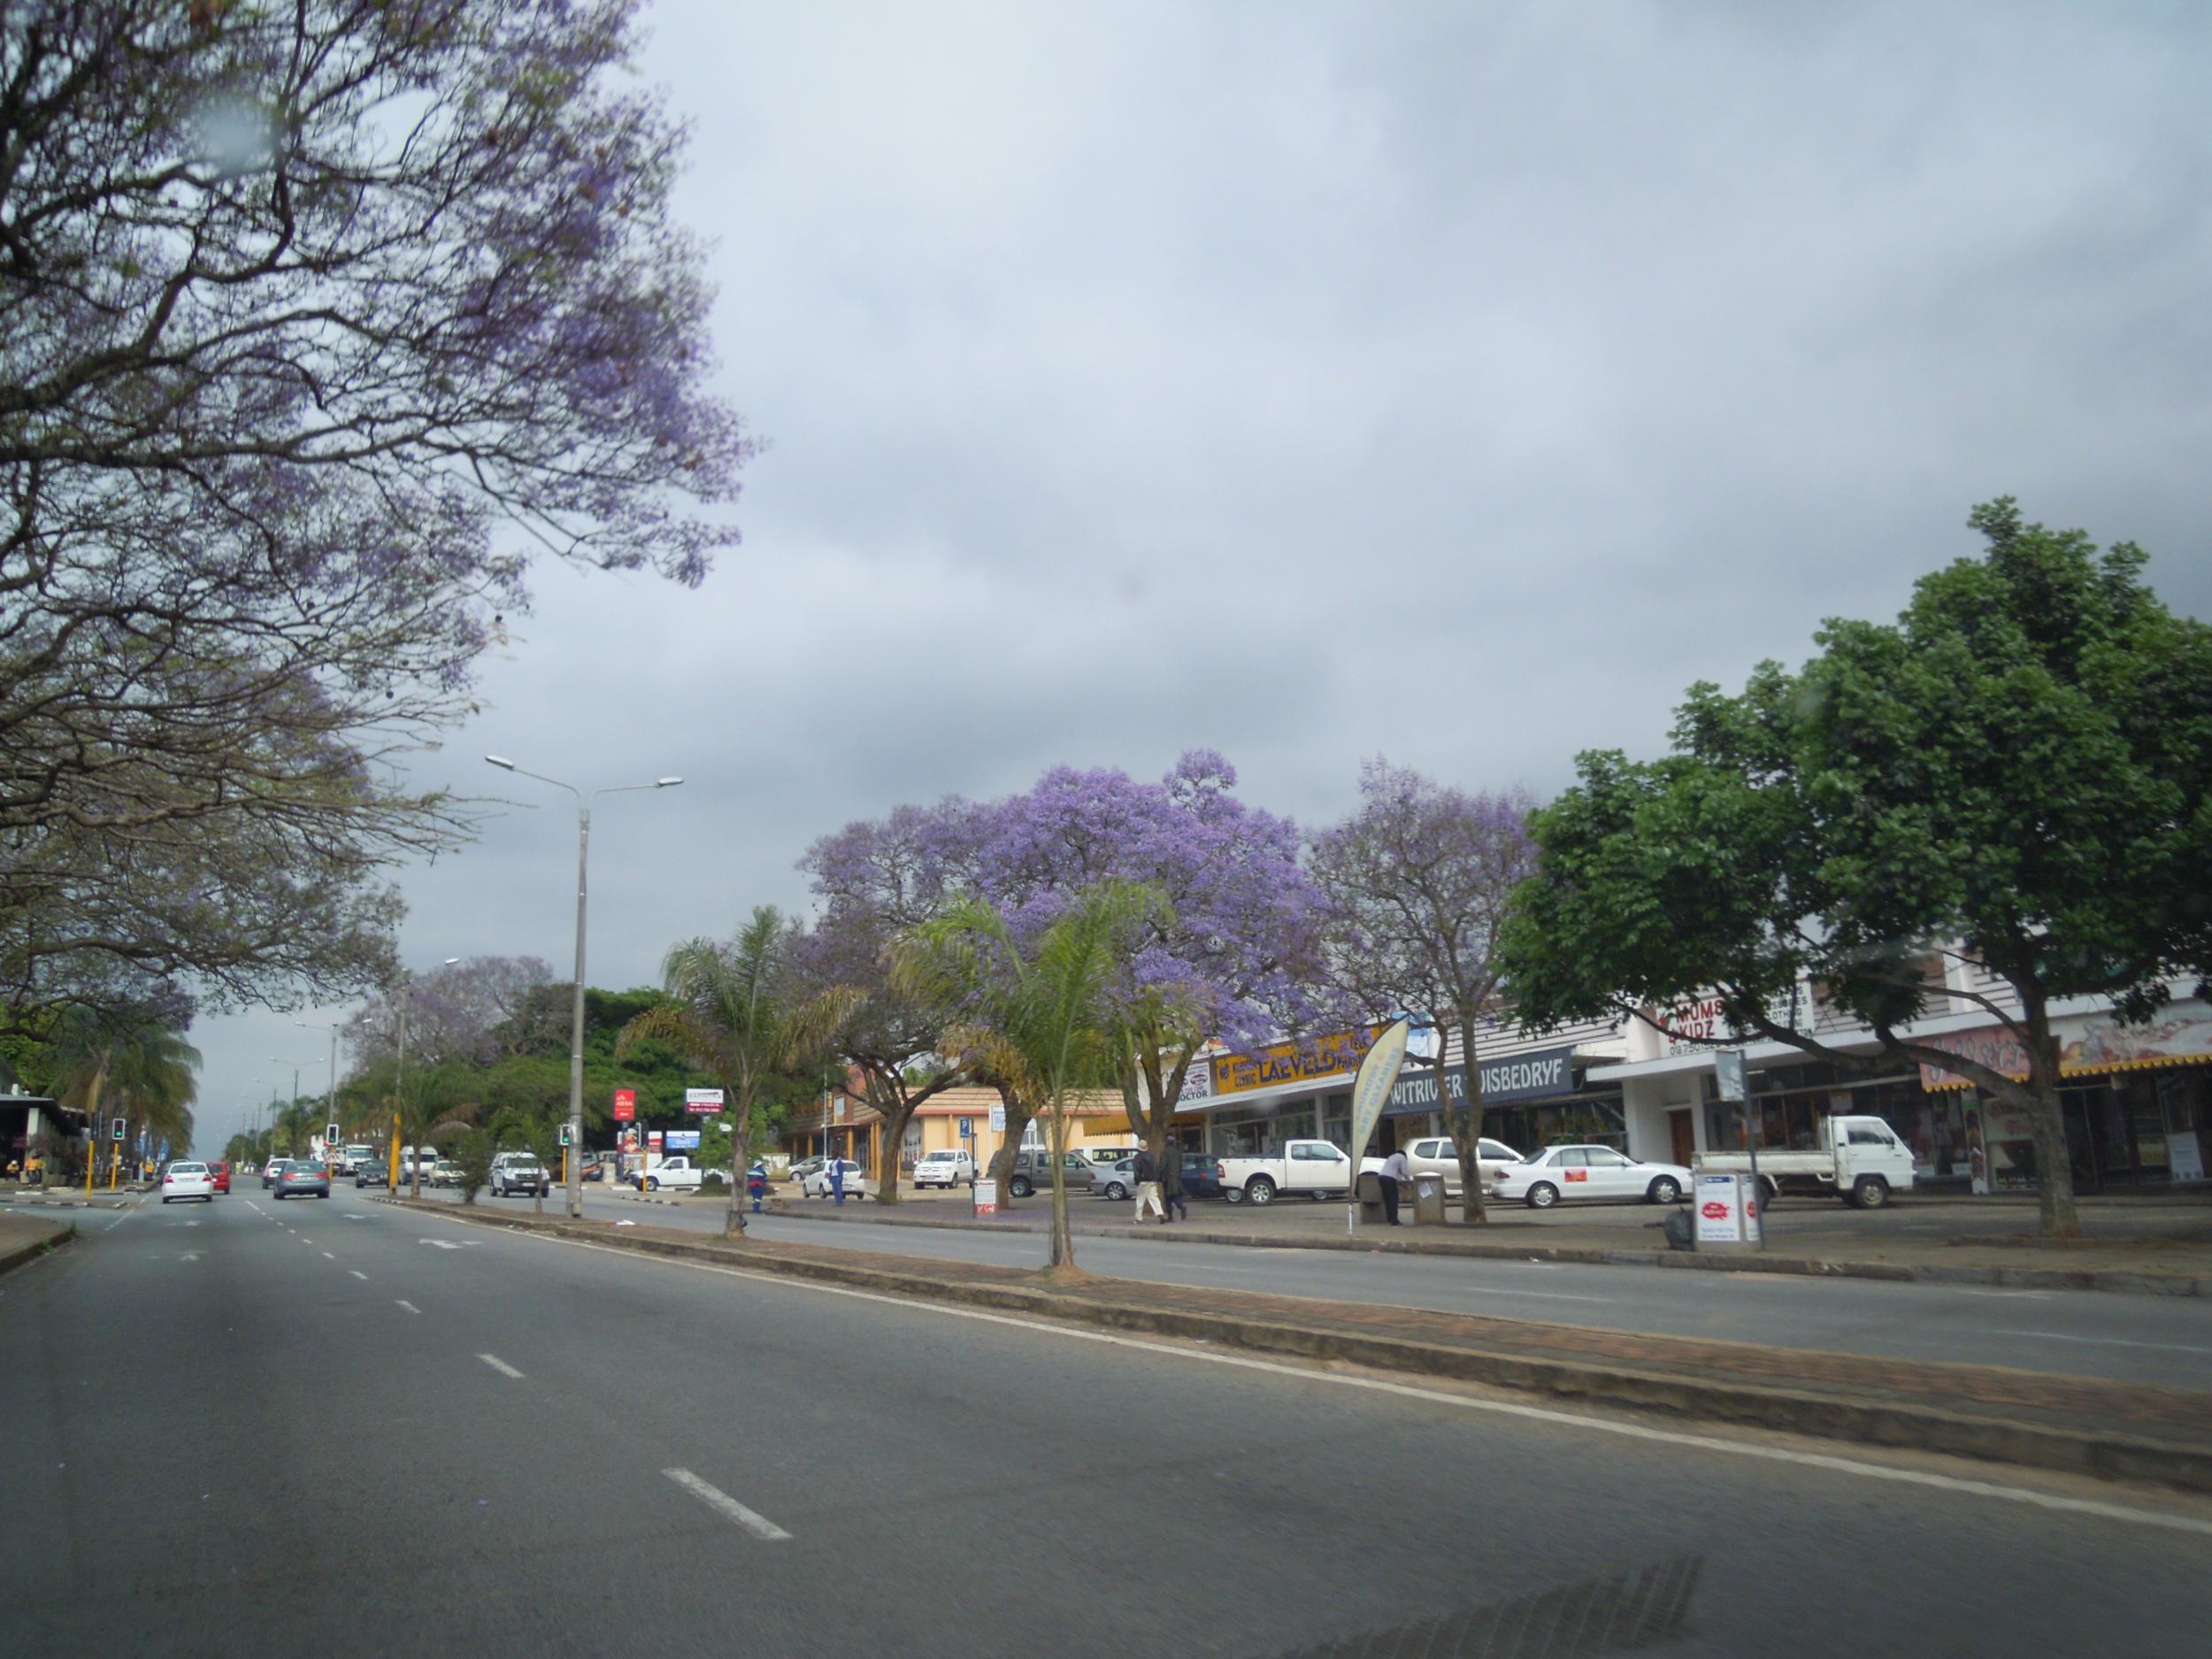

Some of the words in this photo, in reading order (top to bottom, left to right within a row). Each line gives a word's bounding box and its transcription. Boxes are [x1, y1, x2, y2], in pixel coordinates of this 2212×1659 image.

[1679, 1020, 1715, 1040] KIDZ
[1179, 1090, 1208, 1102] OCTOR
[962, 1120, 967, 1129] P
